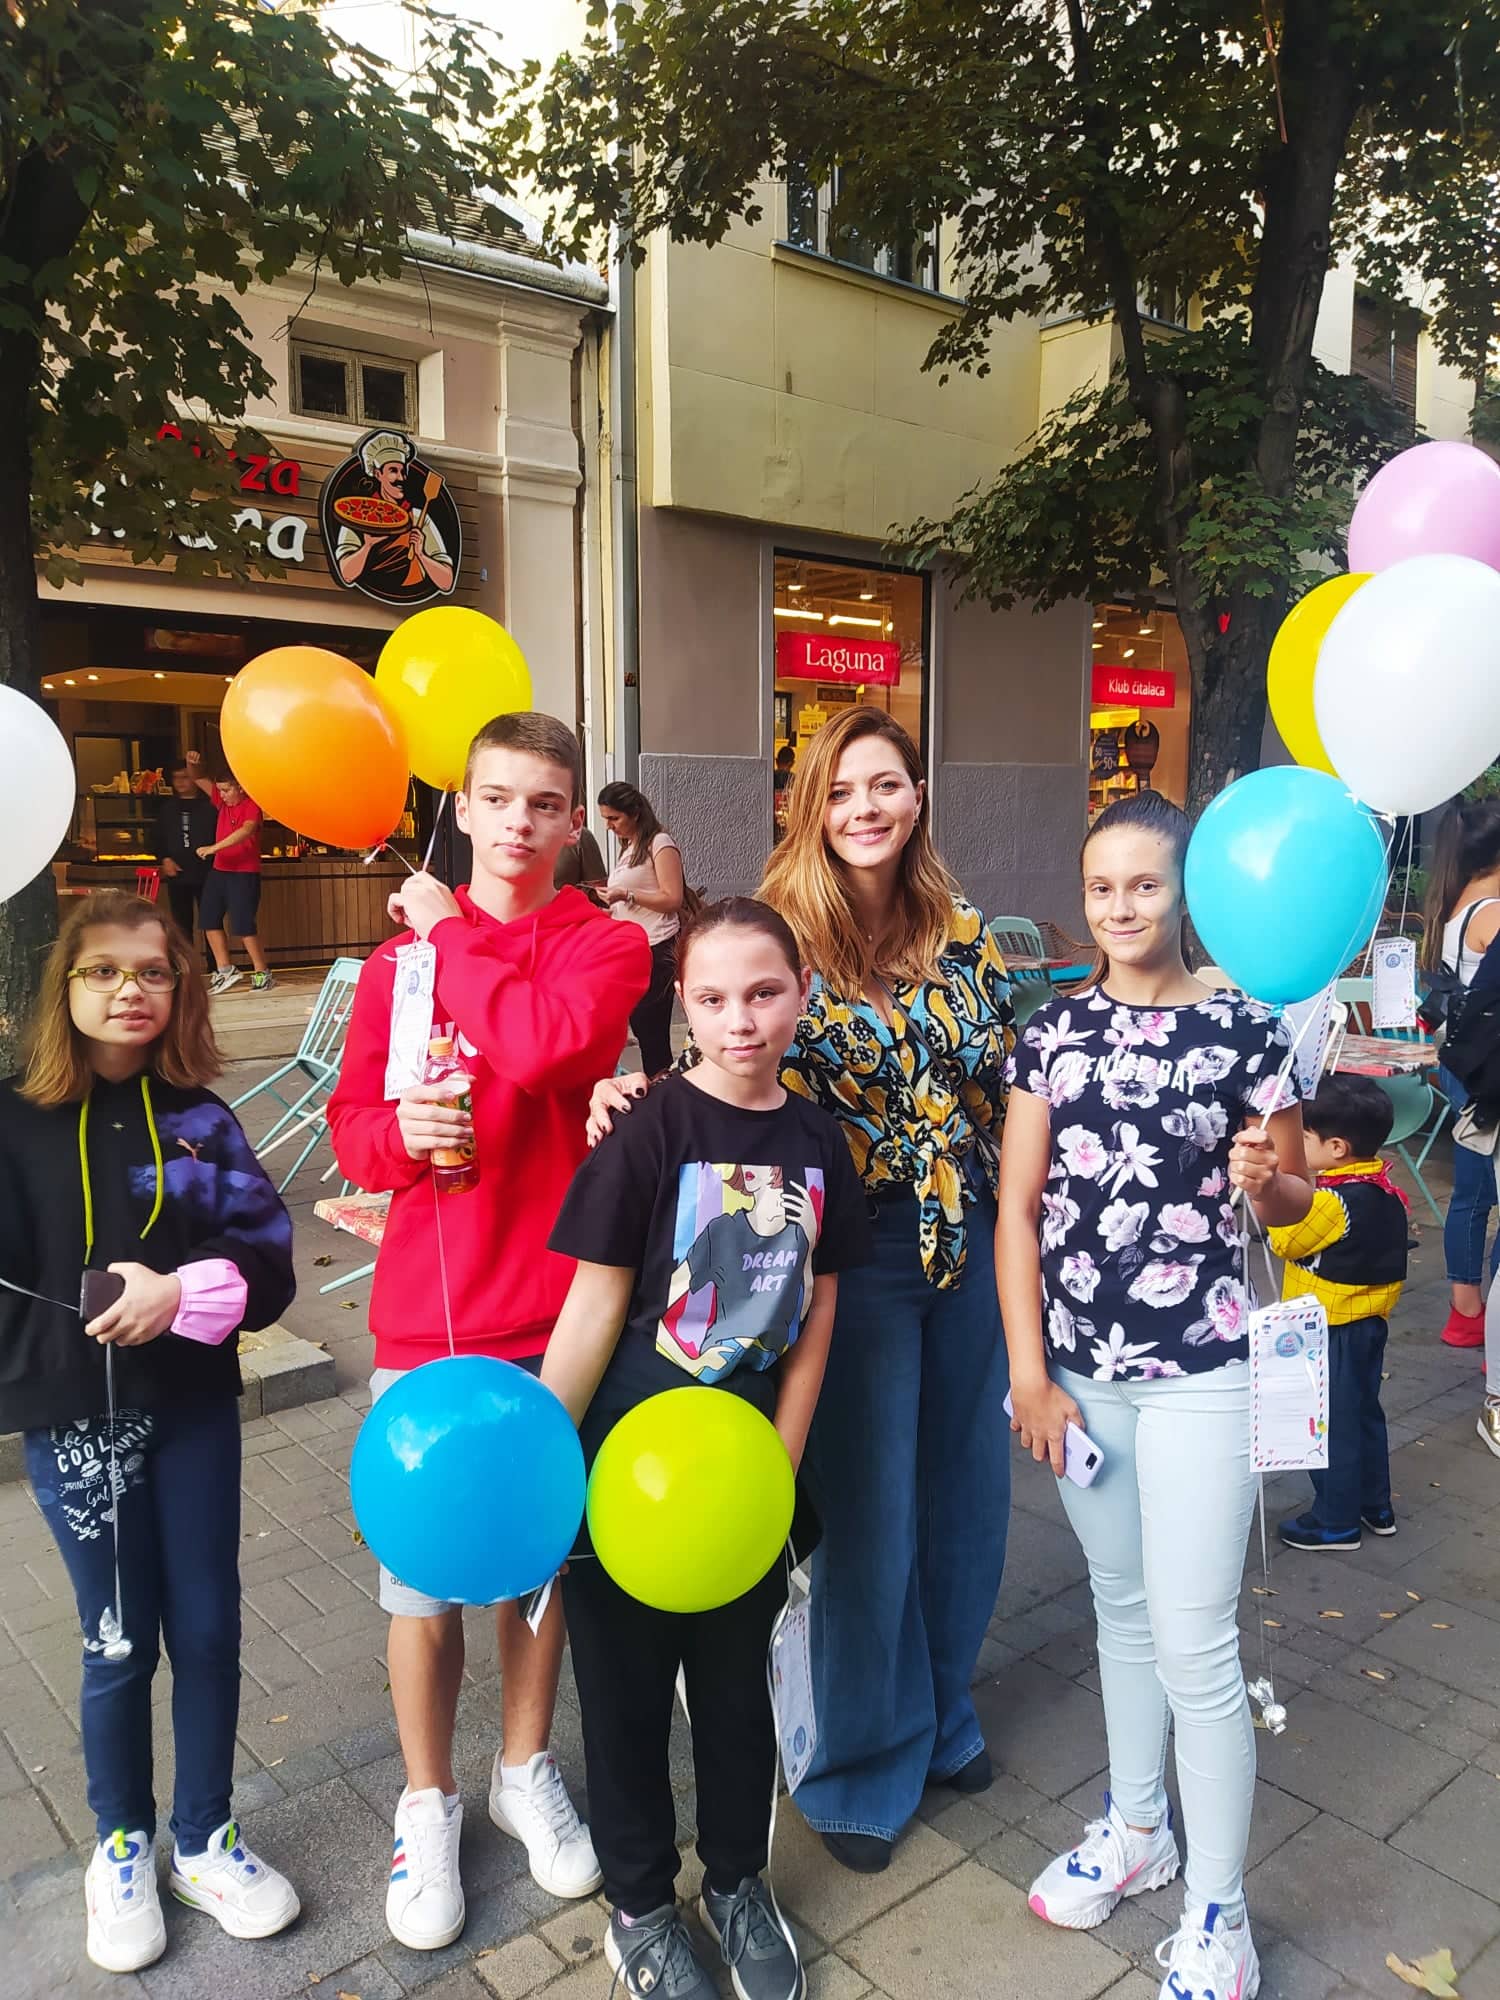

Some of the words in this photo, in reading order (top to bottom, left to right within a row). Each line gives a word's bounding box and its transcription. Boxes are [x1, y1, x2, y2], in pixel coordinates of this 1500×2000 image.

[805, 642, 885, 674] Laguna
[1108, 680, 1130, 695] Klub
[1156, 1058, 1200, 1097] BAY
[742, 1250, 798, 1271] DREAM
[750, 1274, 788, 1293] ART
[57, 1436, 111, 1473] COOL
[64, 1473, 104, 1491] PRINCESS
